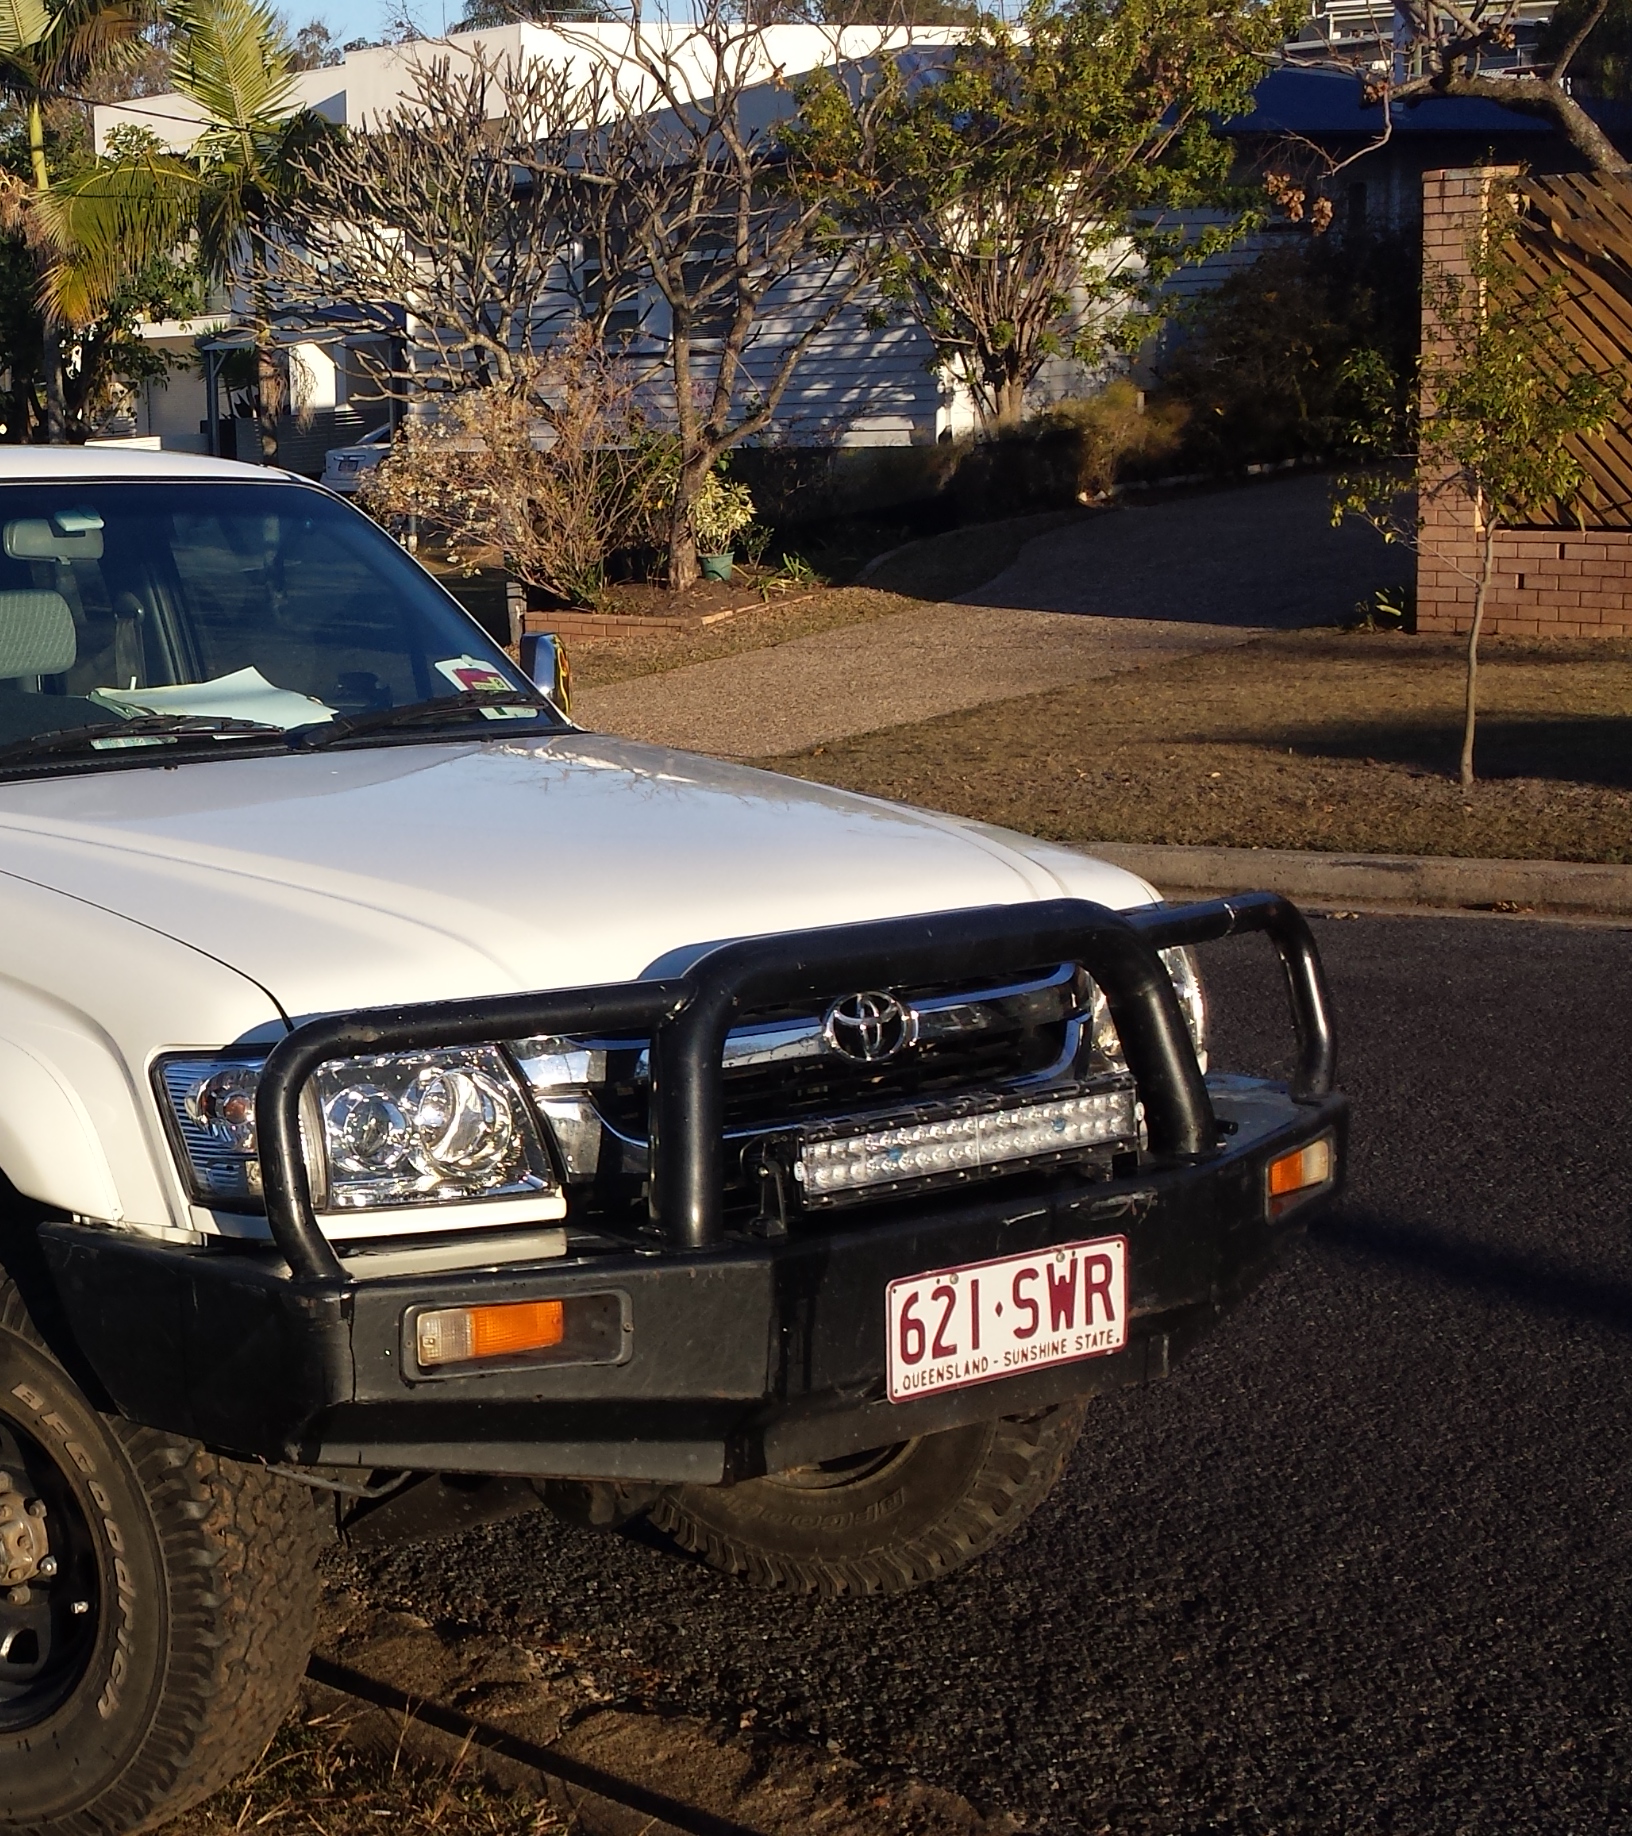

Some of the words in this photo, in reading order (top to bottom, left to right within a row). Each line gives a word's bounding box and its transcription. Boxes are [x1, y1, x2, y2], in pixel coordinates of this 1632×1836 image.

[902, 1356, 989, 1391] QUEENSLAND
[1004, 1339, 1068, 1368] SUNSHINE
[1074, 1329, 1114, 1355] STATE
[11, 1383, 137, 1720] BFGoodrich
